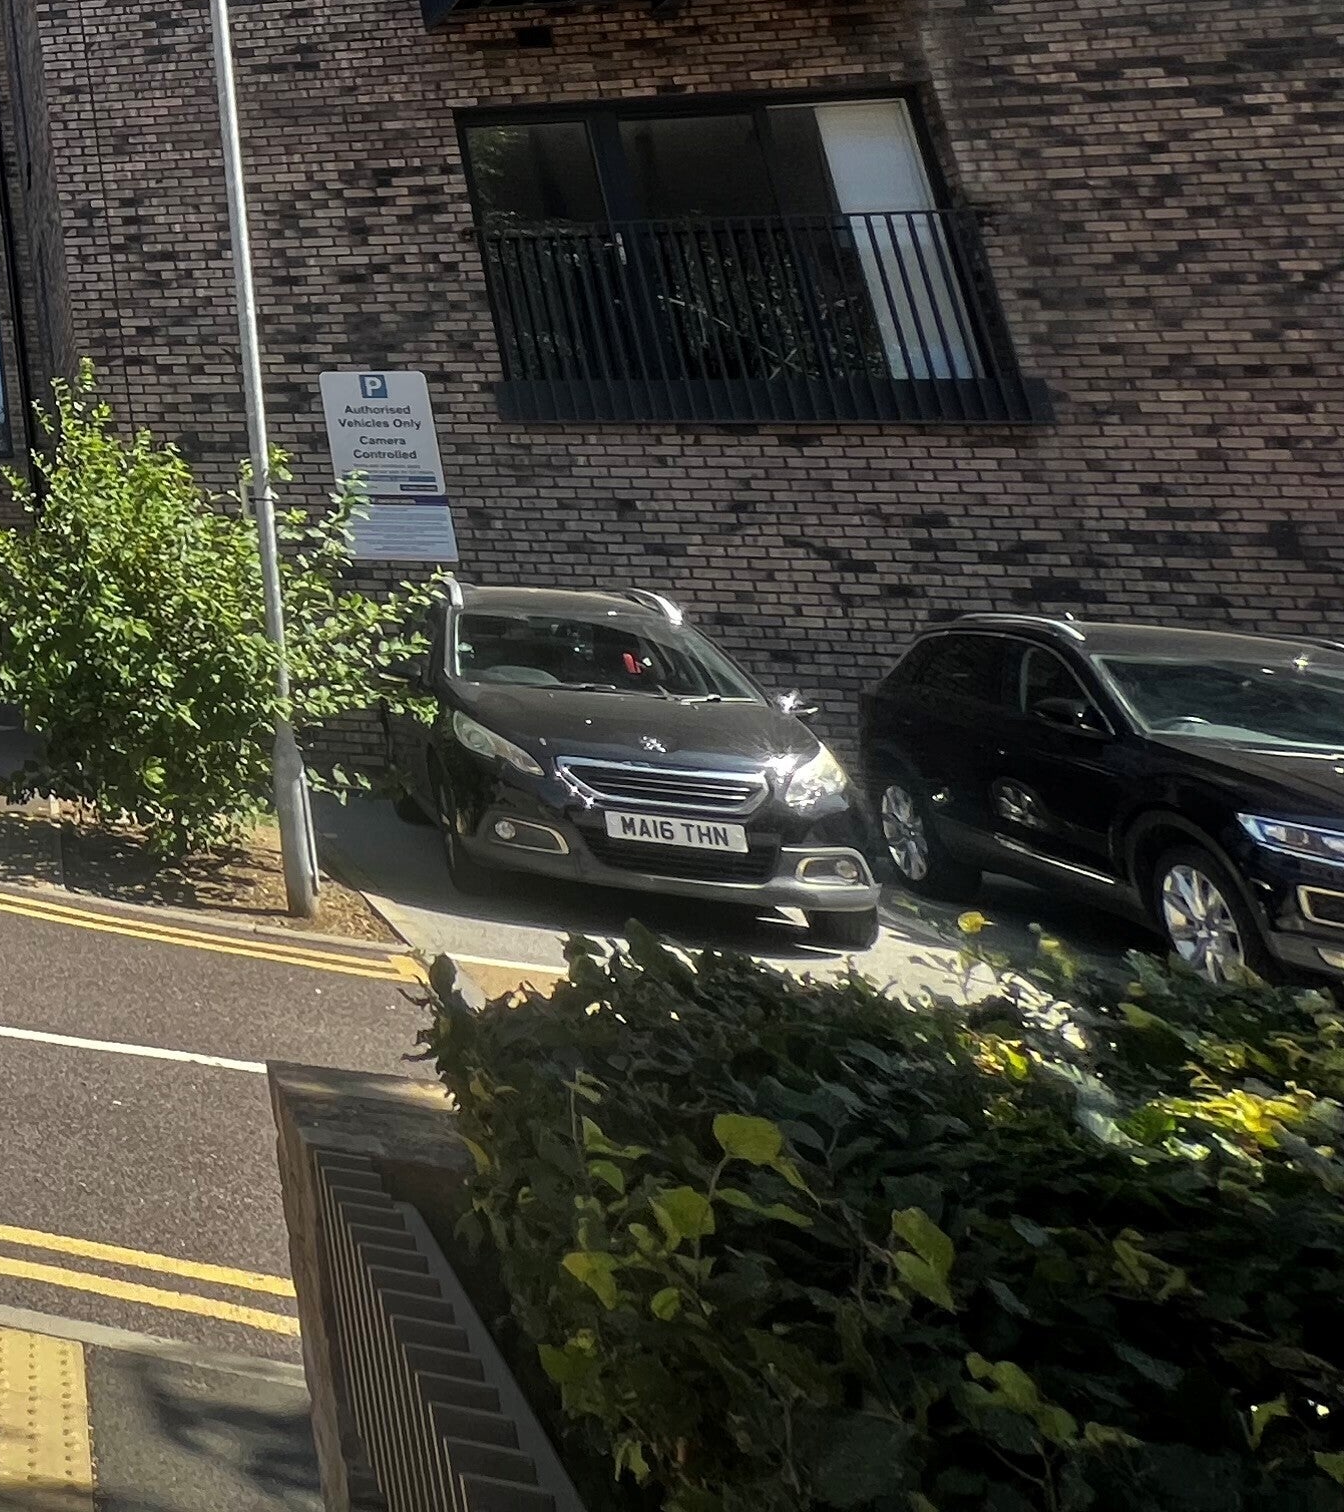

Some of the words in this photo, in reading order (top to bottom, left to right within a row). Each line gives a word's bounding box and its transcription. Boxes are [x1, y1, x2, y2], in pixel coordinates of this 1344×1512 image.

[364, 376, 382, 397] P
[344, 405, 411, 415] Authorised
[338, 418, 390, 428] Vehicles
[393, 418, 422, 431] Only
[359, 436, 407, 446] Camera
[353, 449, 418, 460] Controlled
[620, 816, 675, 840] MA16
[681, 823, 730, 847] THN
